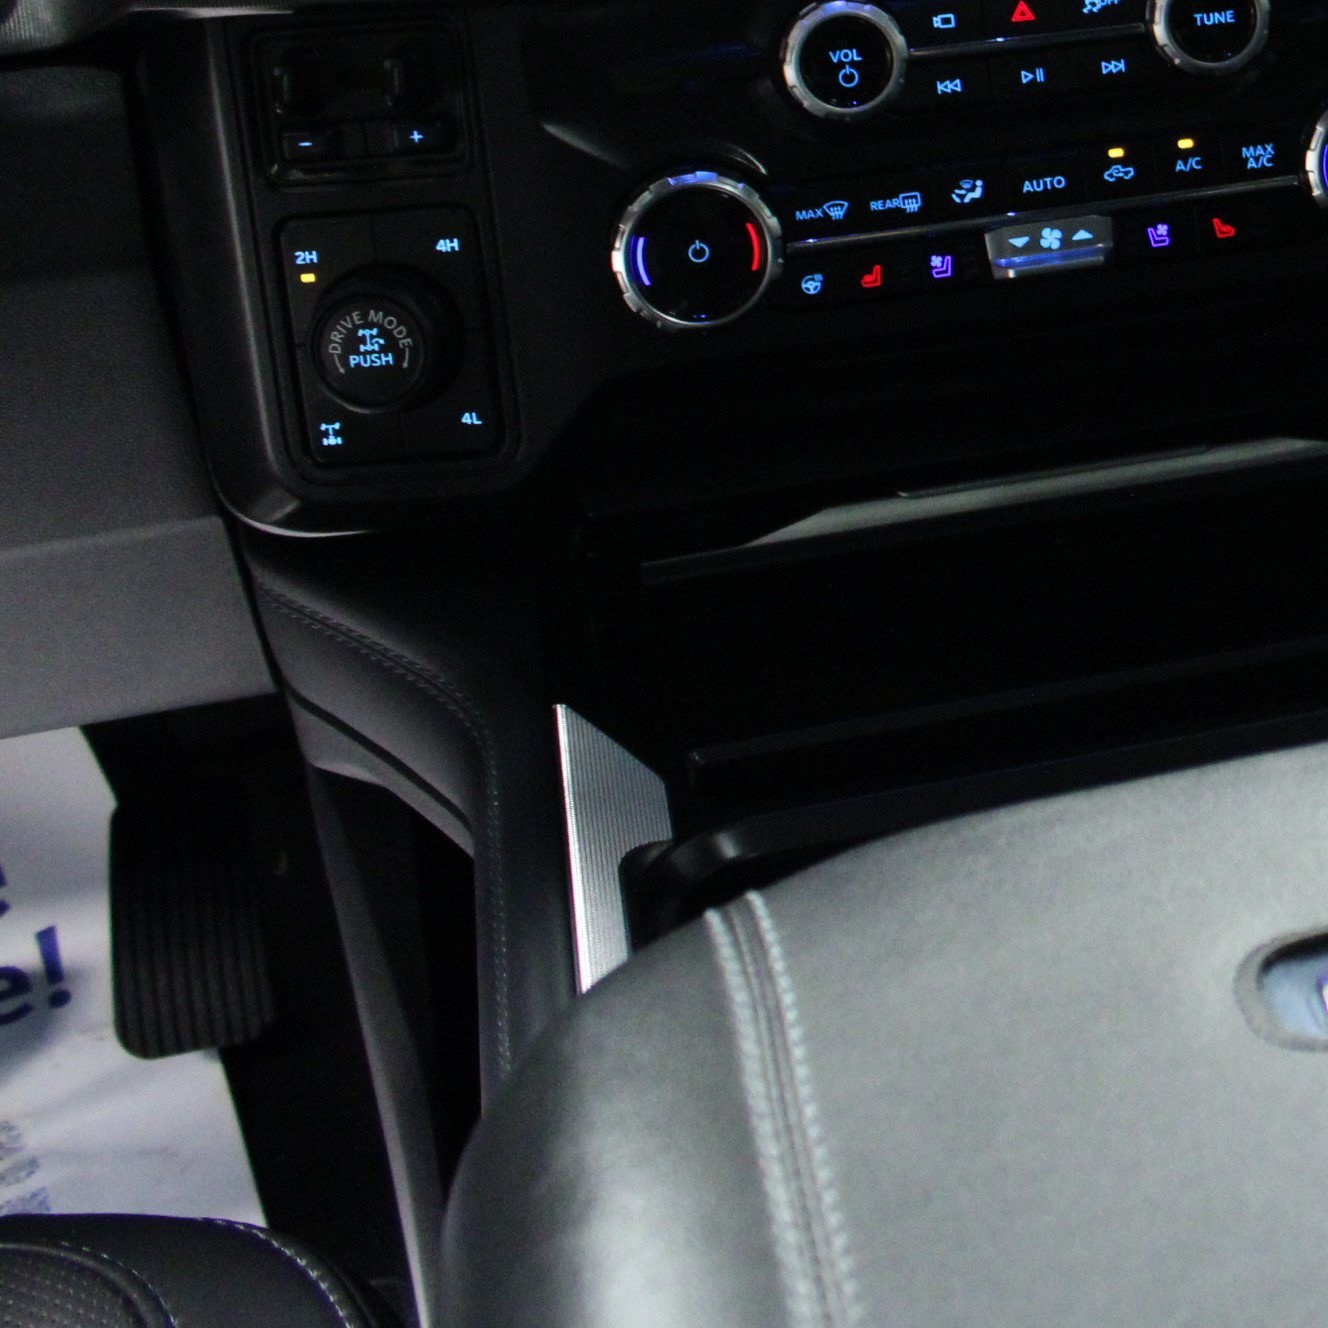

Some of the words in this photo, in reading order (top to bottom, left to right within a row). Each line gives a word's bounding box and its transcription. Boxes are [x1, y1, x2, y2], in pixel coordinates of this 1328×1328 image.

[1194, 10, 1235, 27] TUNE
[829, 49, 862, 63] VOL
[1241, 143, 1275, 159] MAX
[1175, 157, 1202, 172] A/C
[1247, 154, 1274, 169] A/C
[1022, 175, 1066, 194] AUTO
[869, 198, 900, 212] REAR
[795, 208, 823, 221] MAX
[435, 238, 460, 252] 4H
[295, 250, 318, 264] 2H
[328, 310, 363, 354] DRIVE
[368, 309, 413, 349] MODE
[348, 352, 394, 368] PUSH
[461, 412, 483, 425] 4L
